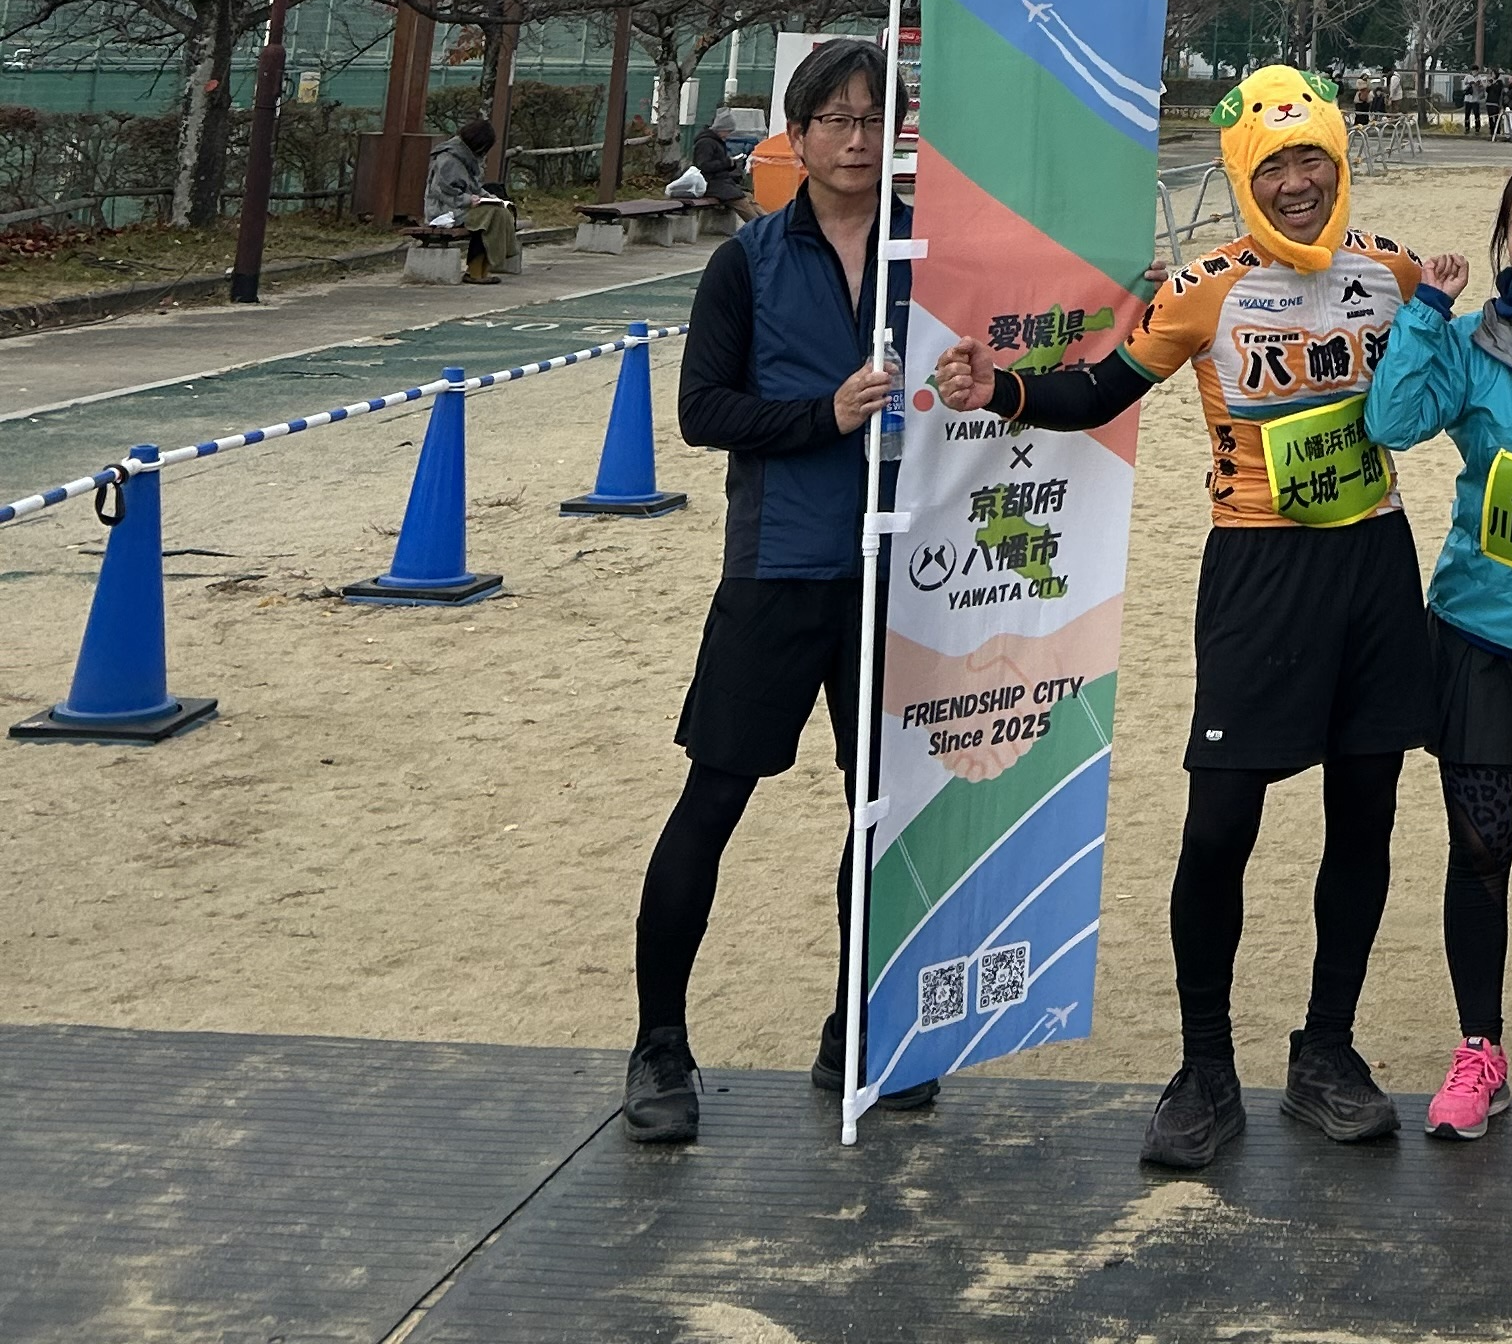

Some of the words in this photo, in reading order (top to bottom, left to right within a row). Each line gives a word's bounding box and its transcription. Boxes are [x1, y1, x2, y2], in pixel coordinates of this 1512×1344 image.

[1238, 297, 1275, 309] WAVE
[1279, 295, 1304, 308] ONE
[987, 308, 1086, 352] 愛媛県
[967, 478, 1069, 523] 京都府
[1279, 445, 1384, 513] 大城一郎
[961, 529, 1063, 576] 八幡市
[948, 582, 1022, 611] YAWATA
[1028, 574, 1069, 599] CITY
[902, 684, 1026, 730] FRIENDSHIP
[1033, 676, 1085, 705] CITY
[928, 729, 984, 756] Since
[990, 710, 1052, 746] 2025
